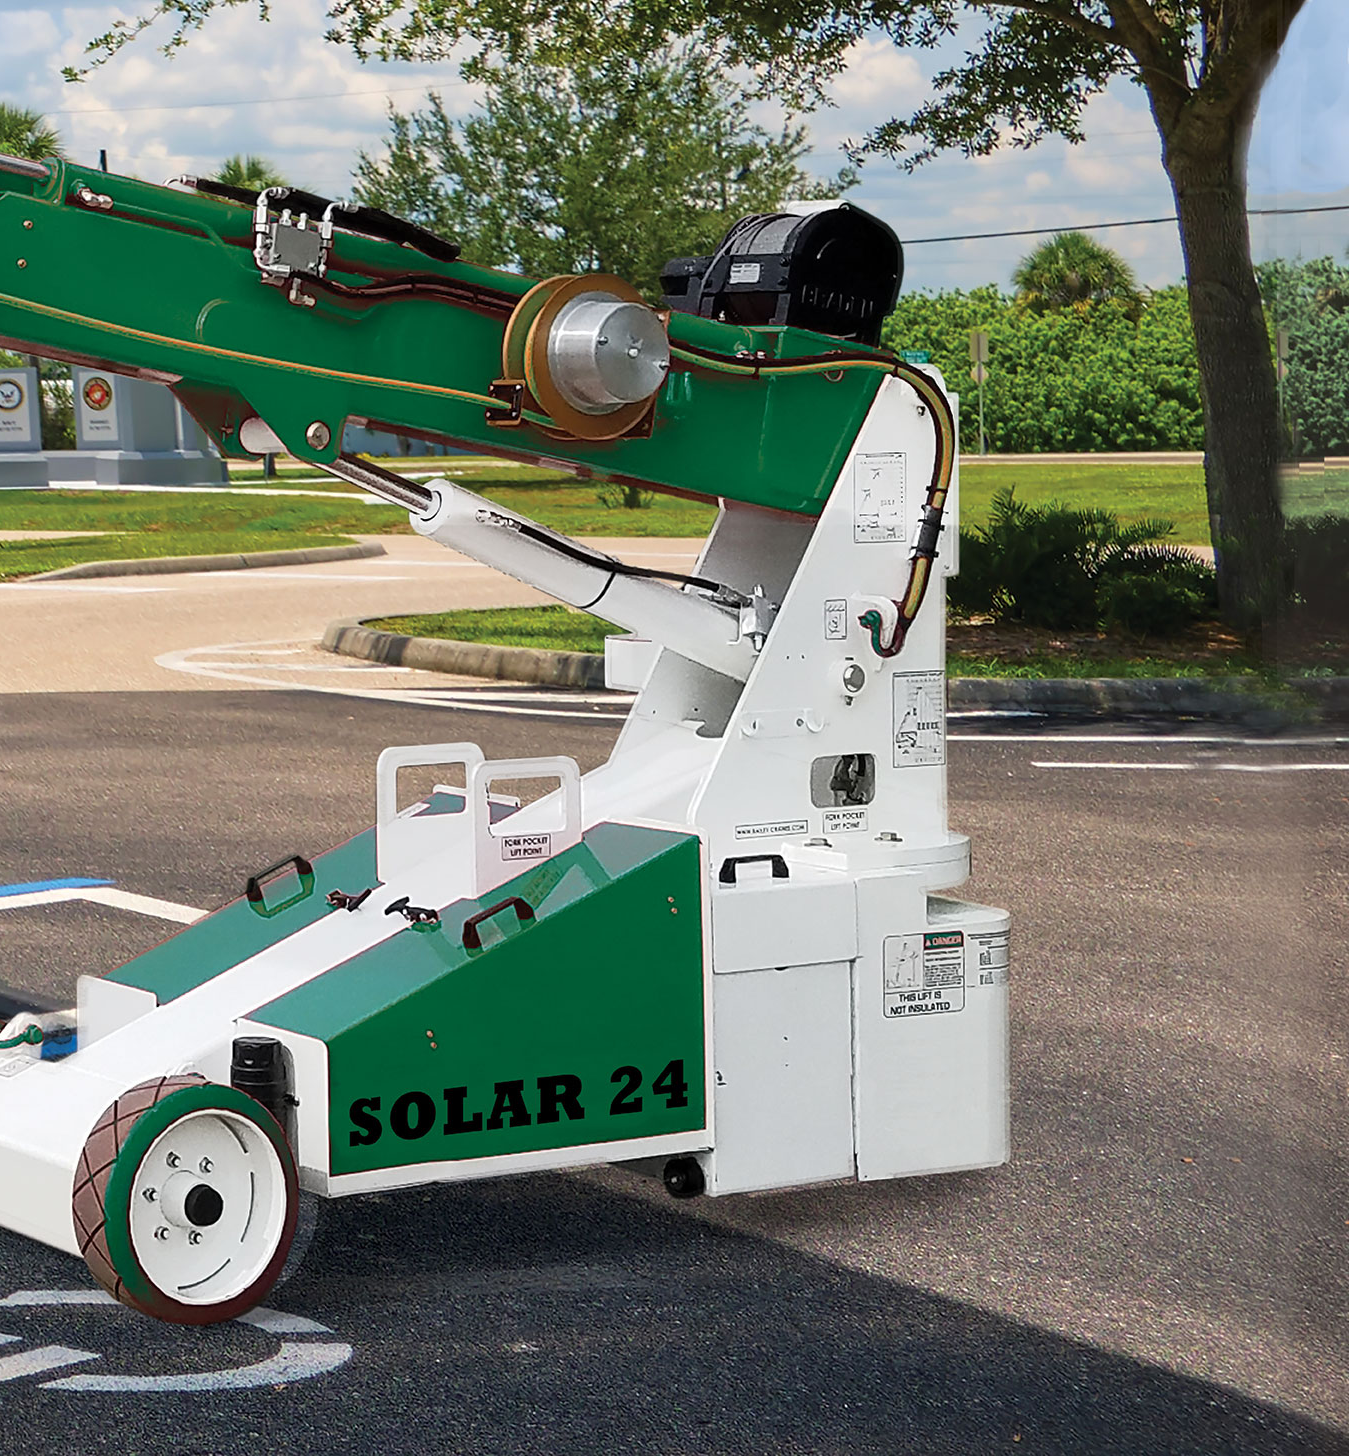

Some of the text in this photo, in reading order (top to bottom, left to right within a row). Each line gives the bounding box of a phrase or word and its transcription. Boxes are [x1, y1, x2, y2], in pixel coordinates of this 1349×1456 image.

[504, 837, 548, 847] FORK POCKET
[510, 847, 543, 856] LIFT POINT
[899, 991, 942, 1002] THIS LIFT IS
[890, 1001, 951, 1015] NOT INSULATED
[349, 1059, 688, 1147] SOLAR 24
